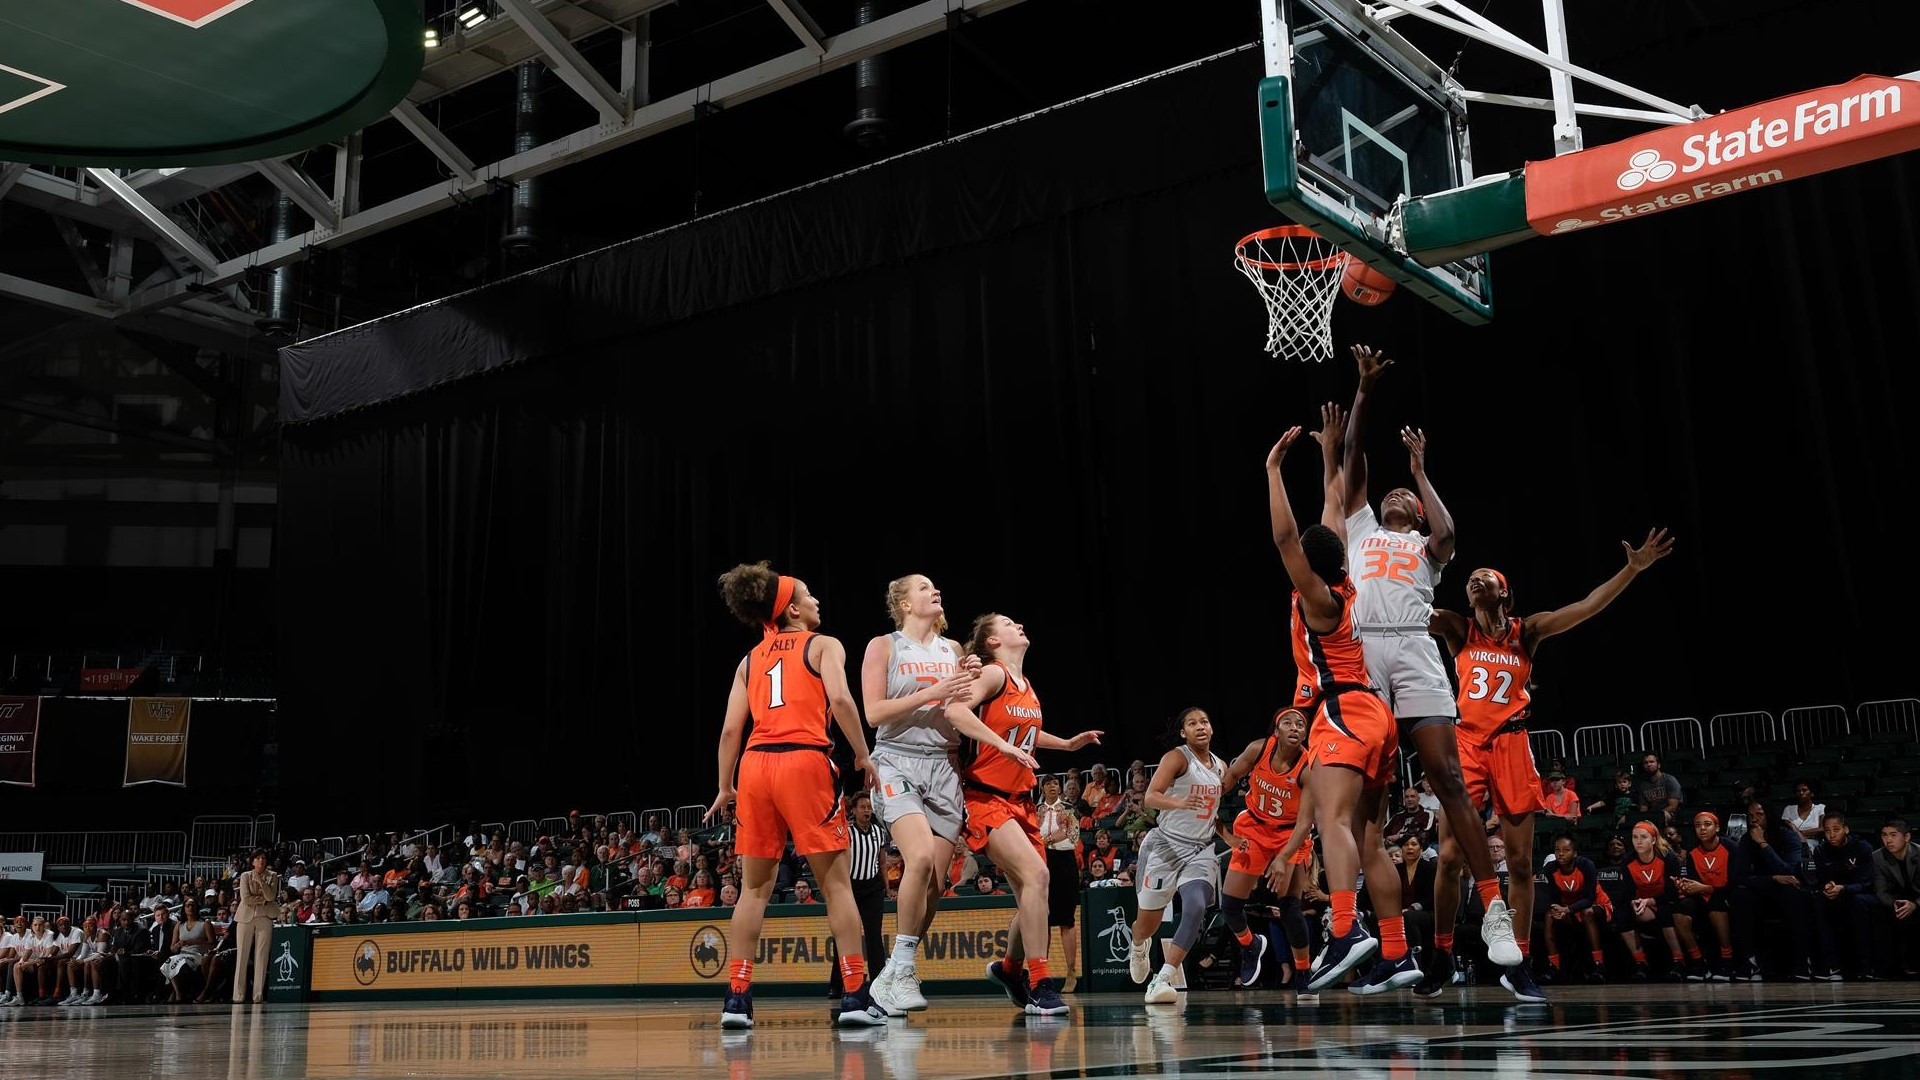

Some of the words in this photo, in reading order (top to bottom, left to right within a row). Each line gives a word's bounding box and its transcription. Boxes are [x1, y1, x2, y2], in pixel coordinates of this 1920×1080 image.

[1361, 550, 1419, 585] 32
[1469, 651, 1521, 667] VIRGINIA
[765, 657, 786, 710] 1
[1467, 665, 1513, 705] 32
[1007, 724, 1038, 757] 14
[1255, 775, 1292, 800] VIRGINIA
[1258, 794, 1284, 818] 13
[386, 948, 465, 973] BUFFALO
[471, 946, 519, 970] WILD
[524, 943, 591, 969] WINGS
[753, 936, 834, 964] UFFALO
